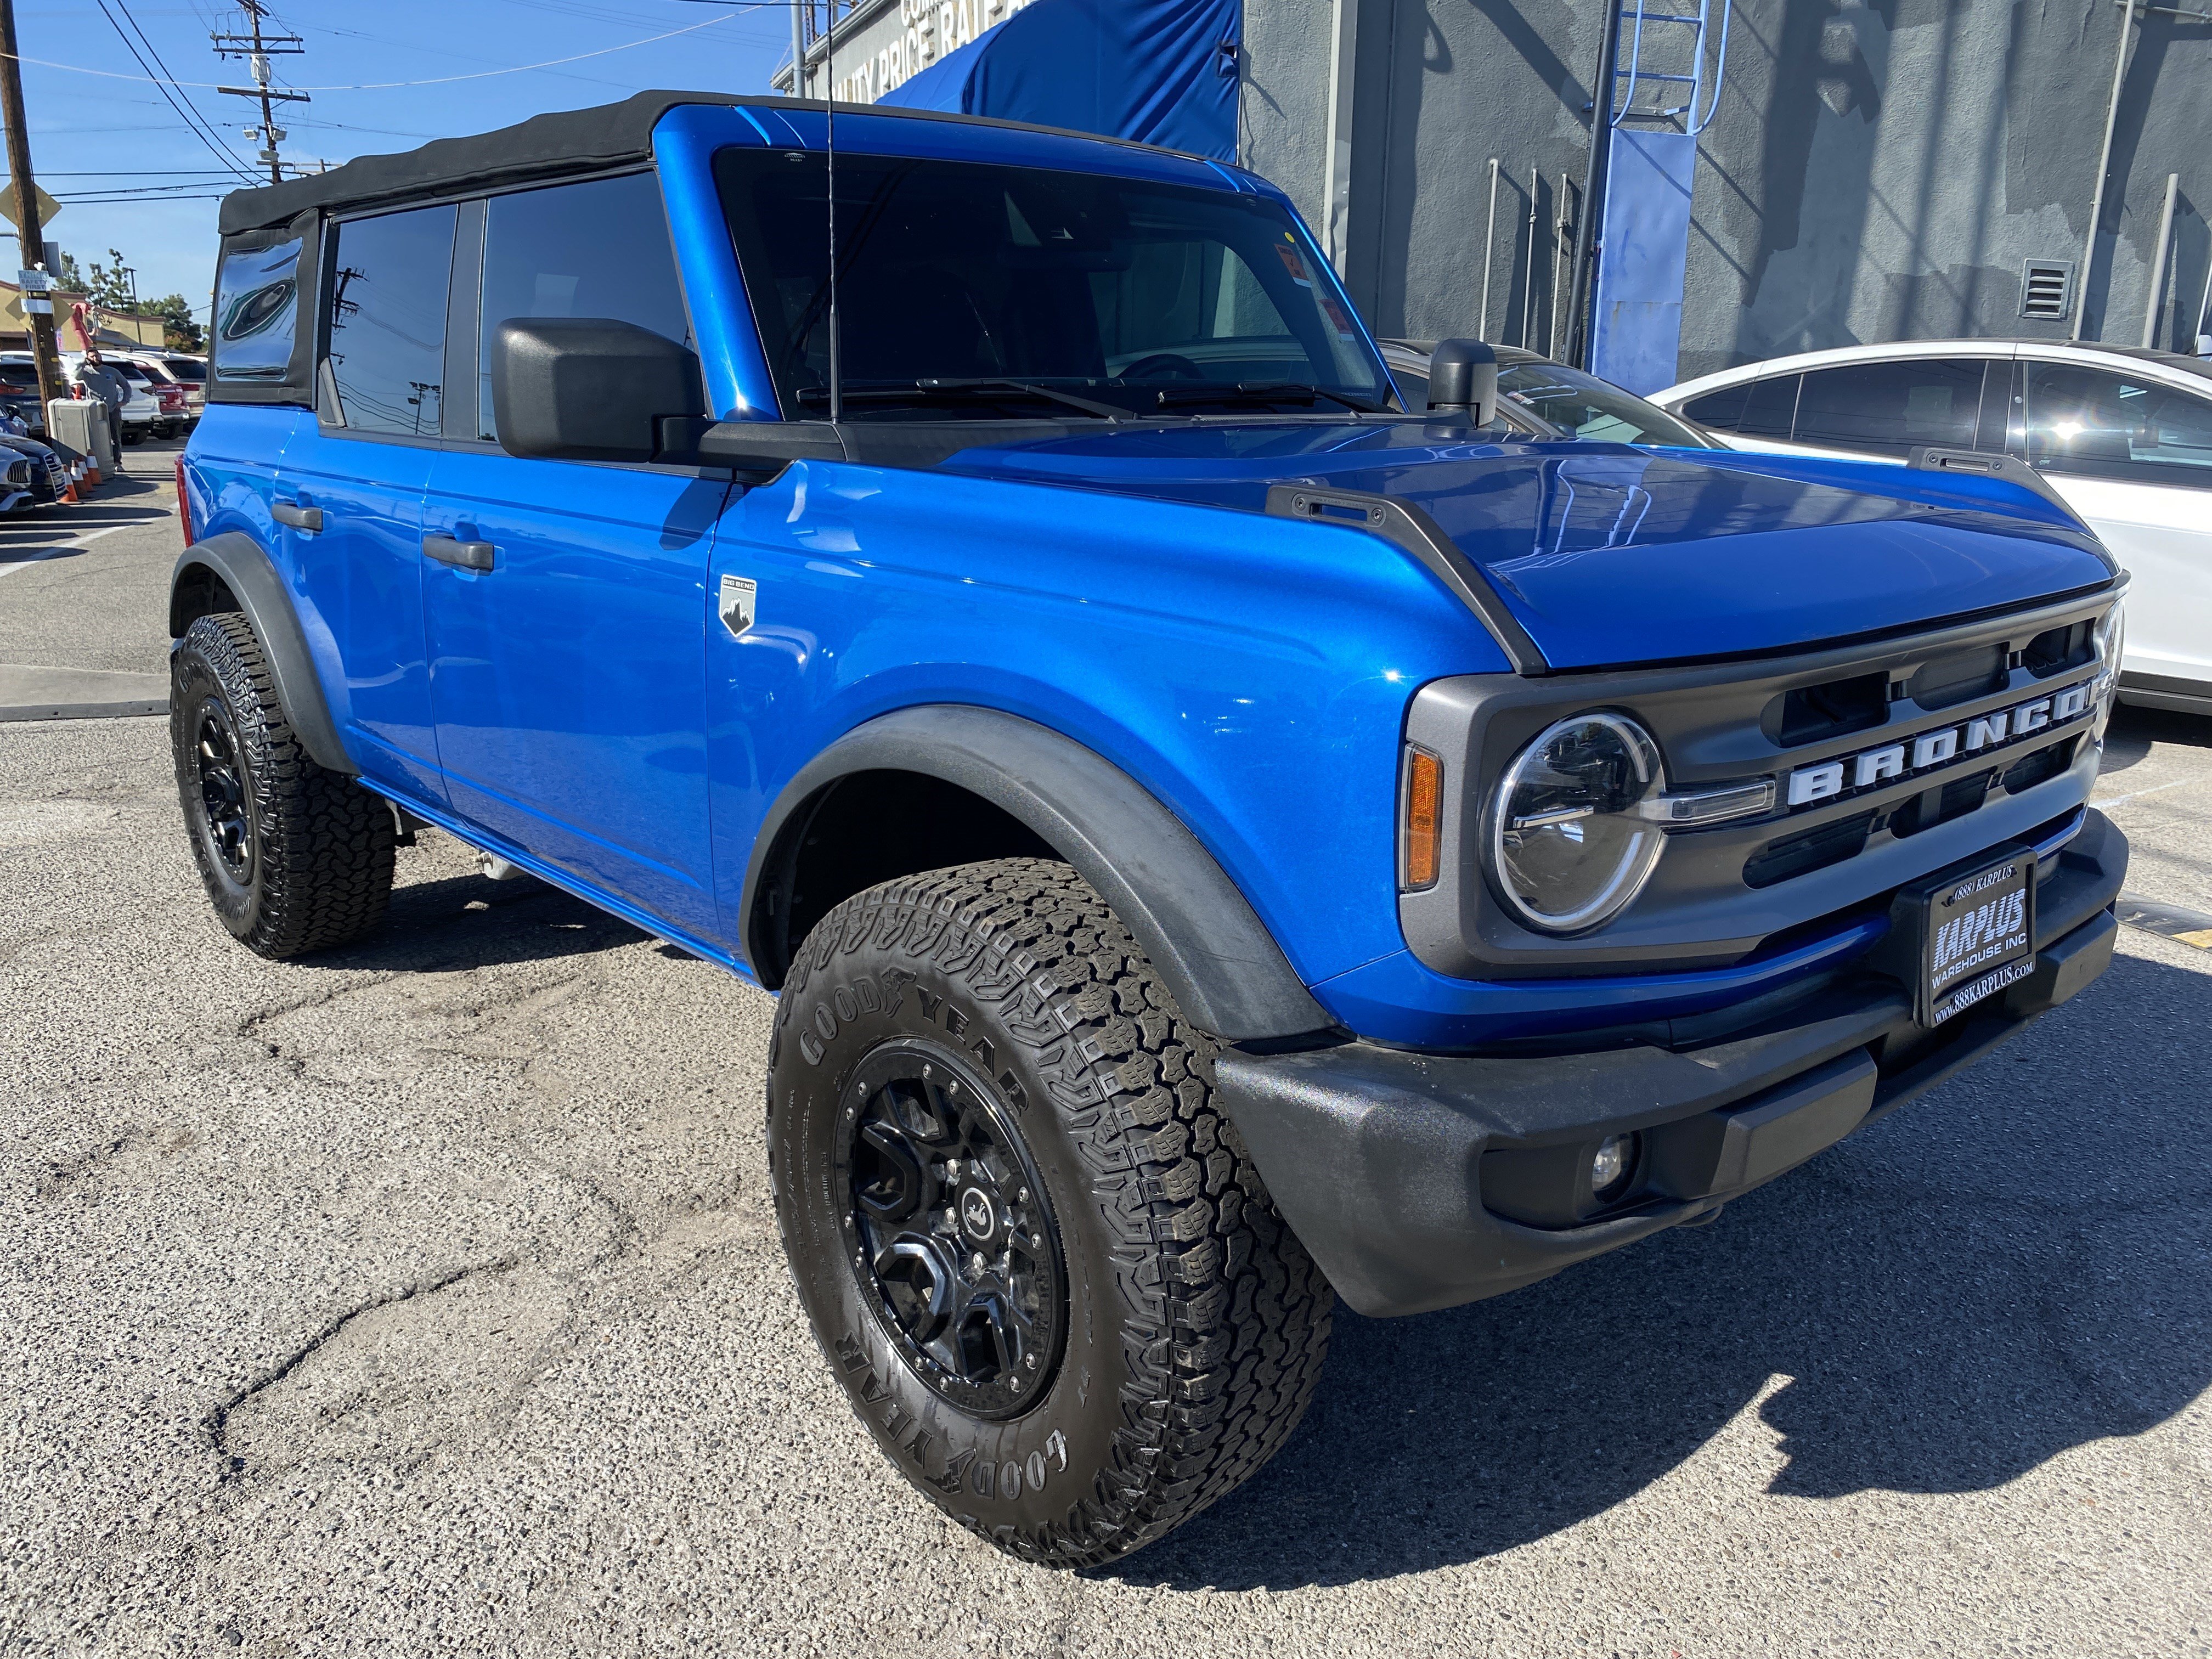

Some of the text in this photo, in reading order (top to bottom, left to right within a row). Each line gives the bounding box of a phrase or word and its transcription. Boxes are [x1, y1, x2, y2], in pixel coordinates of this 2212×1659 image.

[879, 18, 929, 97] PRICE
[1788, 686, 2087, 805] BRONCO
[1954, 864, 2013, 901] (888) KARPLUS
[1932, 888, 2026, 972] KARPLUS
[1932, 932, 2027, 989] WAREHOUSE INC
